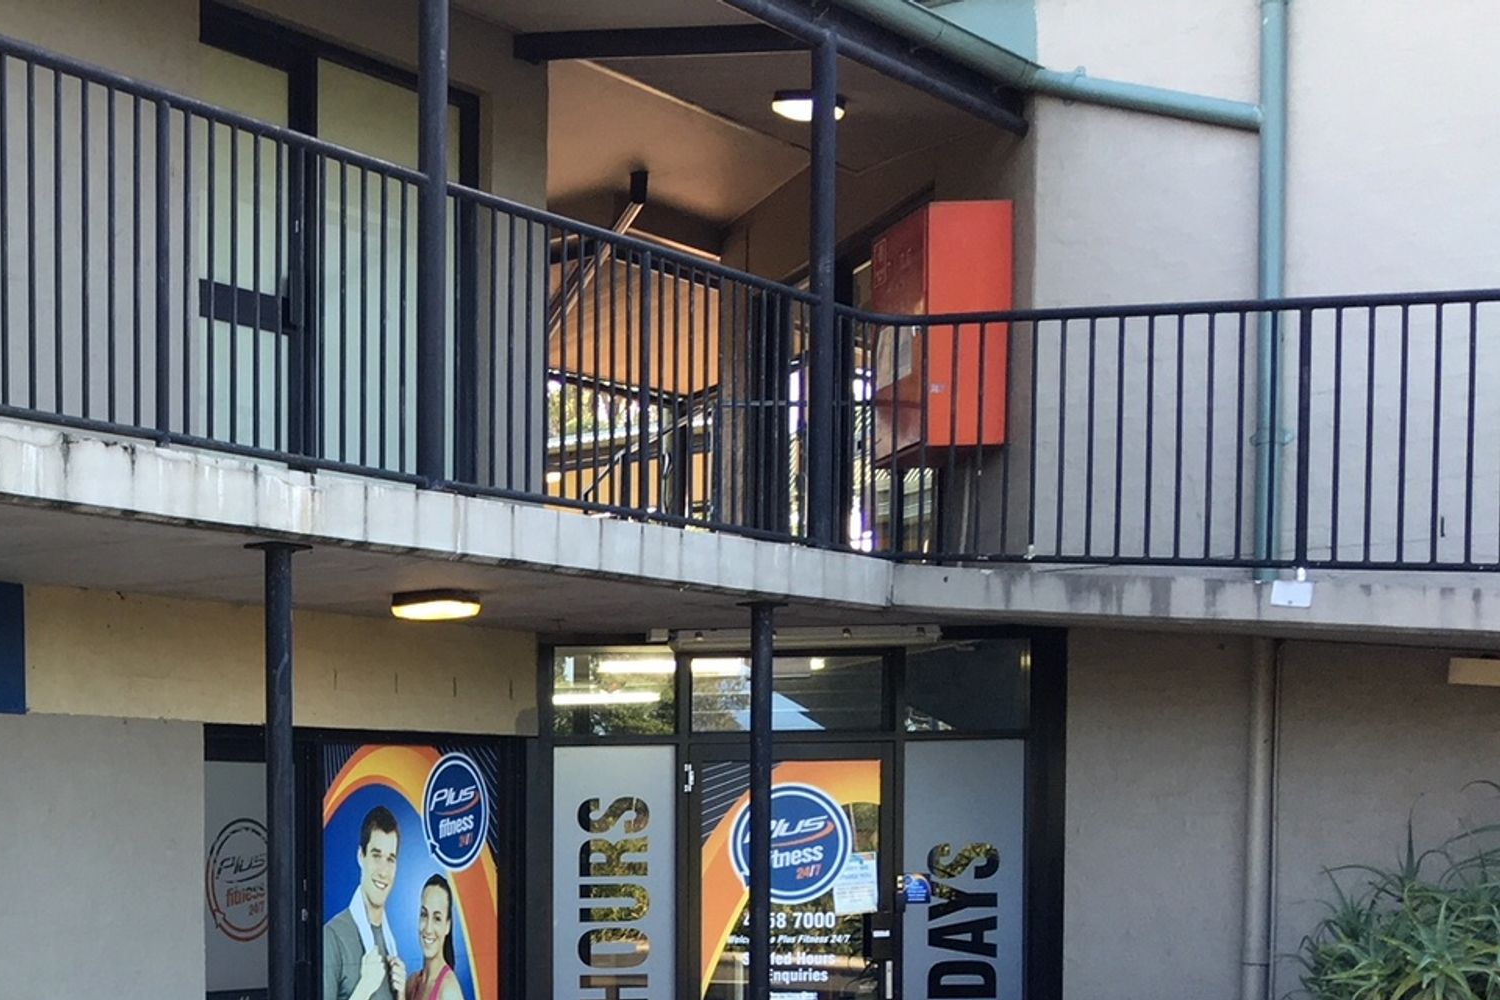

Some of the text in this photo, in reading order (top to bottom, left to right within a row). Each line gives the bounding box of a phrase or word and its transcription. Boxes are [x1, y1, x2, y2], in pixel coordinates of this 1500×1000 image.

[438, 814, 475, 839] fitness
[795, 863, 823, 880] 24/7
[793, 911, 836, 929] 7000
[927, 842, 1000, 999] DAYS
[796, 951, 837, 966] Hours
